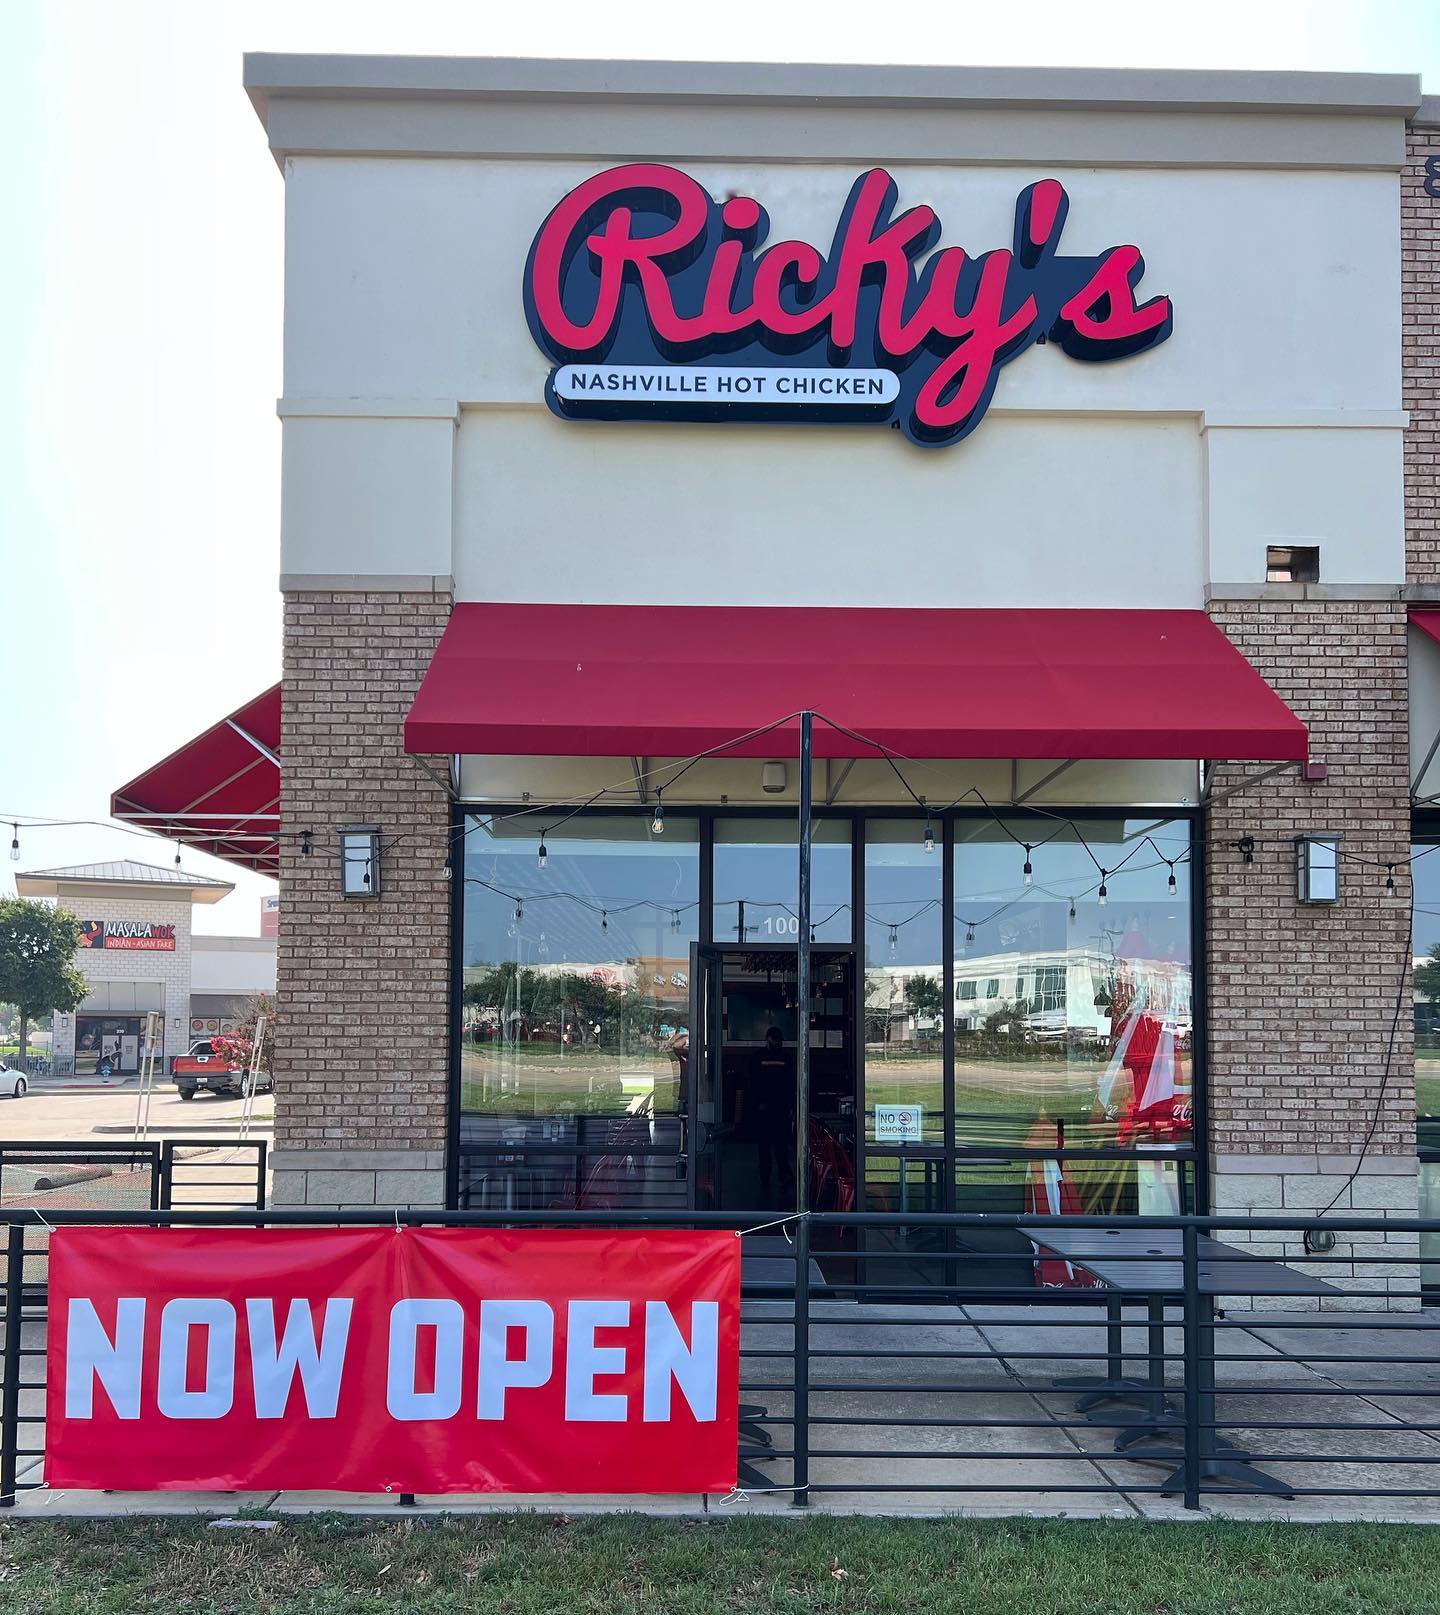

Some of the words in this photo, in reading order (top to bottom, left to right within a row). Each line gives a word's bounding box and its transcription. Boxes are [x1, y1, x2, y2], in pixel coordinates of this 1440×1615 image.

[532, 163, 1170, 428] Ricky's
[571, 373, 707, 393] NASHVILLE
[717, 376, 767, 394] HOT
[776, 377, 884, 395] CHICKEN
[763, 917, 799, 934] 100
[880, 1113, 895, 1124] NO
[880, 1126, 917, 1134] SMOKING
[65, 1297, 354, 1419] NOW
[386, 1299, 719, 1422] OPEN
